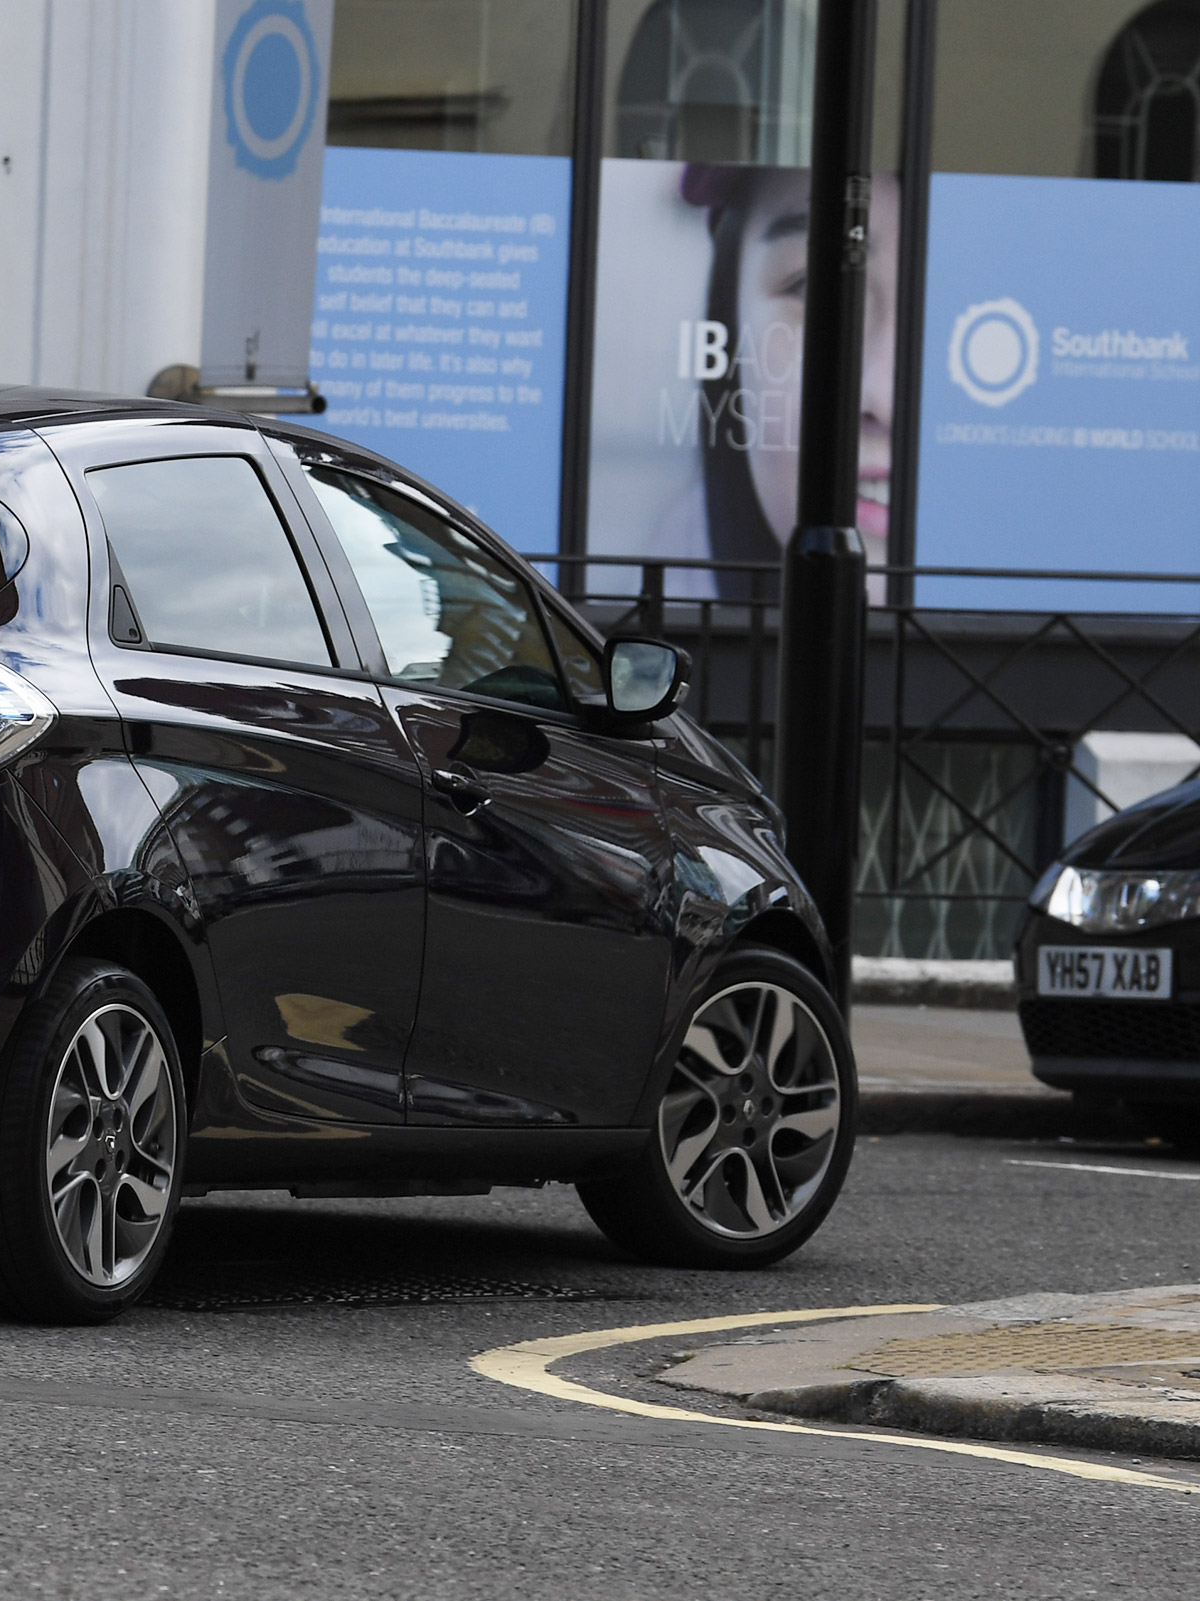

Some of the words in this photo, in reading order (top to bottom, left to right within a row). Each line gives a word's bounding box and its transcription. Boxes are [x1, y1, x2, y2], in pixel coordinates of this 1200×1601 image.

[418, 208, 527, 233] Baccalaureate
[414, 237, 495, 261] Southbank
[497, 243, 539, 264] gives
[327, 265, 393, 285] students
[397, 266, 422, 285] the
[397, 295, 427, 315] that
[430, 295, 462, 318] they
[466, 299, 495, 317] can
[497, 299, 528, 318] and
[331, 321, 372, 341] excel
[395, 324, 465, 345] whatever
[468, 325, 500, 348] they
[504, 328, 543, 347] want
[1052, 326, 1189, 360] Southbank
[328, 349, 348, 369] do
[369, 350, 405, 371] later
[466, 355, 498, 374] also
[500, 356, 533, 379] why
[676, 320, 801, 383] IBAC
[364, 378, 382, 398] of
[384, 380, 425, 399] them
[428, 383, 495, 404] progress
[497, 385, 514, 403] to
[516, 385, 543, 404] the
[384, 408, 419, 428] best
[657, 388, 799, 450] MYSEL
[1046, 951, 1106, 990] YH57
[1113, 953, 1161, 992] XAB
